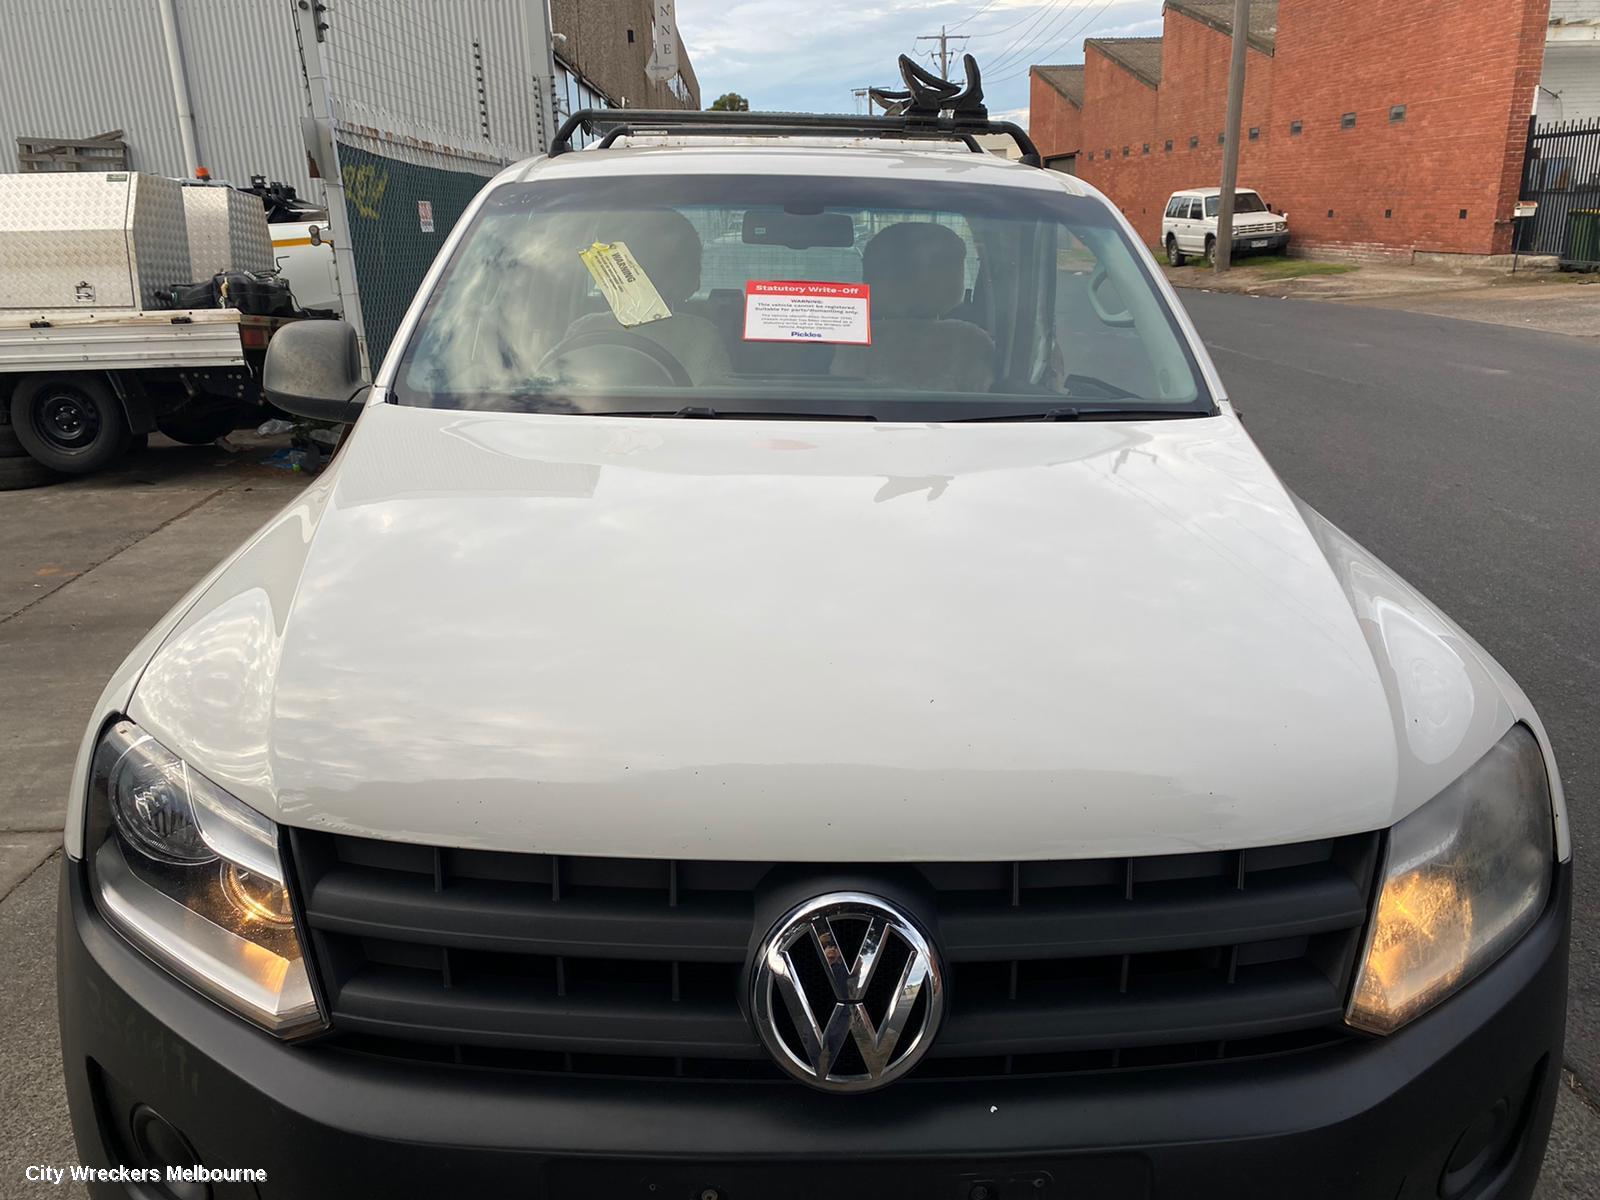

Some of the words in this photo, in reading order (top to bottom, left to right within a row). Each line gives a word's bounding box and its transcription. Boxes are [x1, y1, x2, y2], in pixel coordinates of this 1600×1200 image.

[612, 252, 636, 283] WARNING
[756, 285, 805, 293] Statutory
[808, 286, 859, 294] Write-Off
